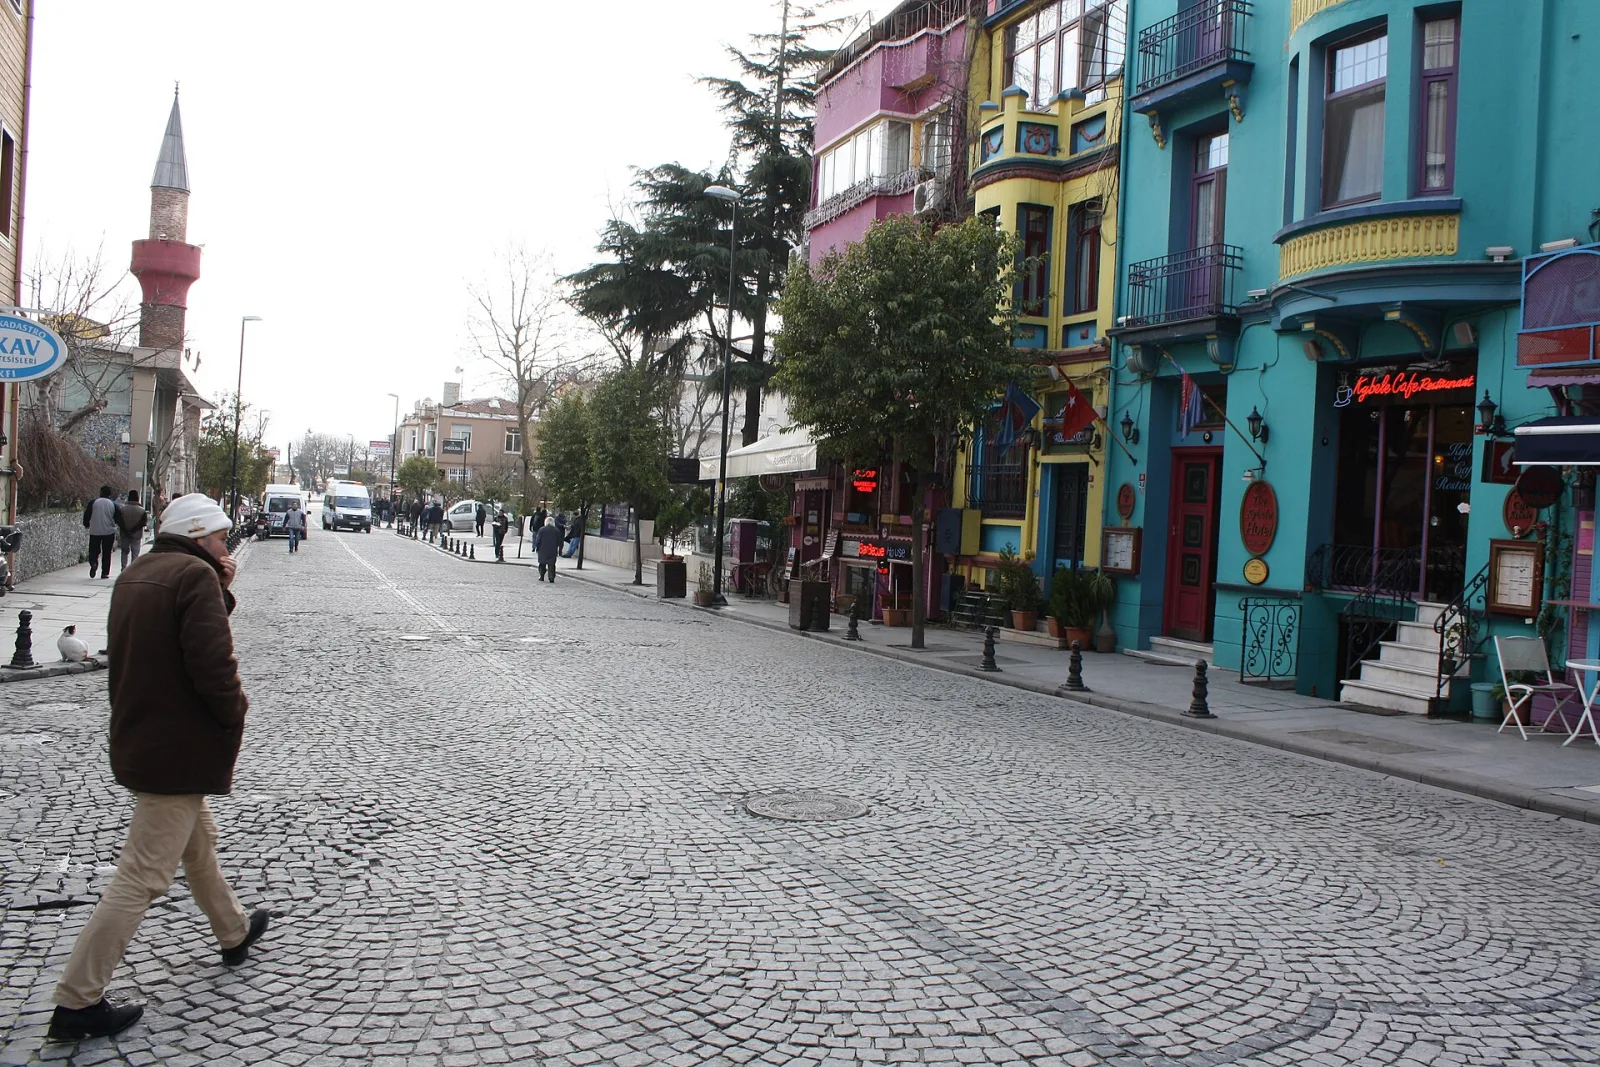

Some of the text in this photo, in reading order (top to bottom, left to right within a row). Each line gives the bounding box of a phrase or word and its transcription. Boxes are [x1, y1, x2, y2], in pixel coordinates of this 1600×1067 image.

[1353, 374, 1391, 403] Kybele
[1392, 372, 1419, 399] Cafe
[1246, 521, 1273, 537] Hotel
